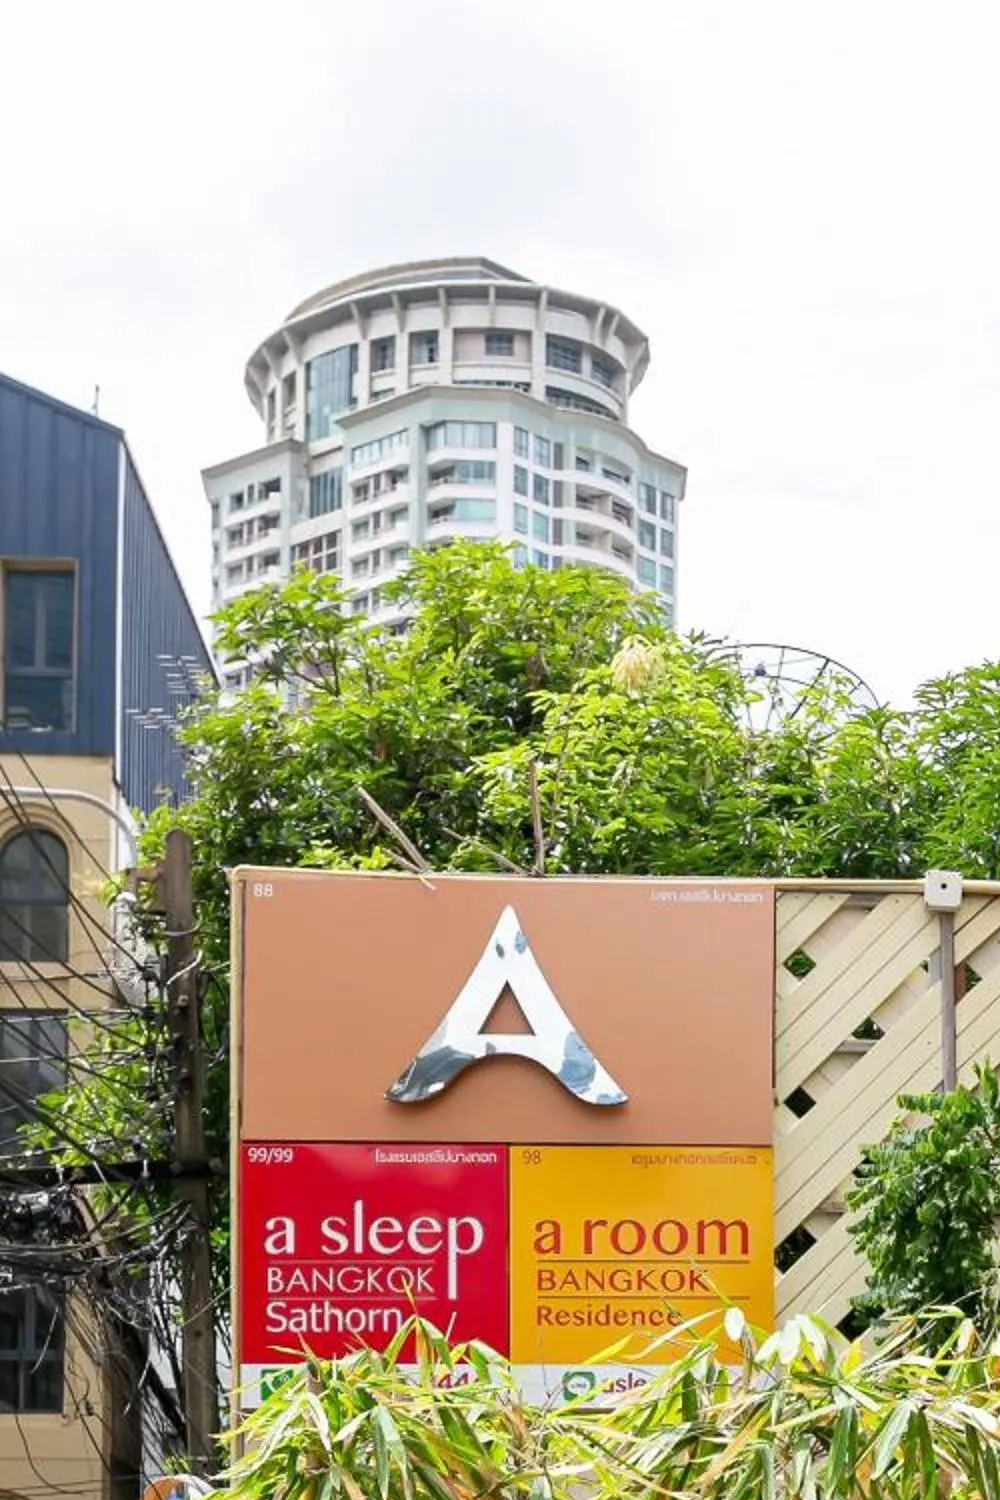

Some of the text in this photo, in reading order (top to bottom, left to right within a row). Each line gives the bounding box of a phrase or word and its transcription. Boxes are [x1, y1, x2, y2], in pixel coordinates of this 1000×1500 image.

[253, 883, 273, 897] 88
[384, 904, 629, 1106] A
[247, 1147, 293, 1165] 99/99
[264, 1199, 484, 1300] a sleep
[533, 1219, 749, 1255] a room
[267, 1266, 434, 1293] BANGKOK
[536, 1269, 711, 1292] BANGKOK
[265, 1301, 403, 1333] Sathorn
[536, 1304, 683, 1326] Residence
